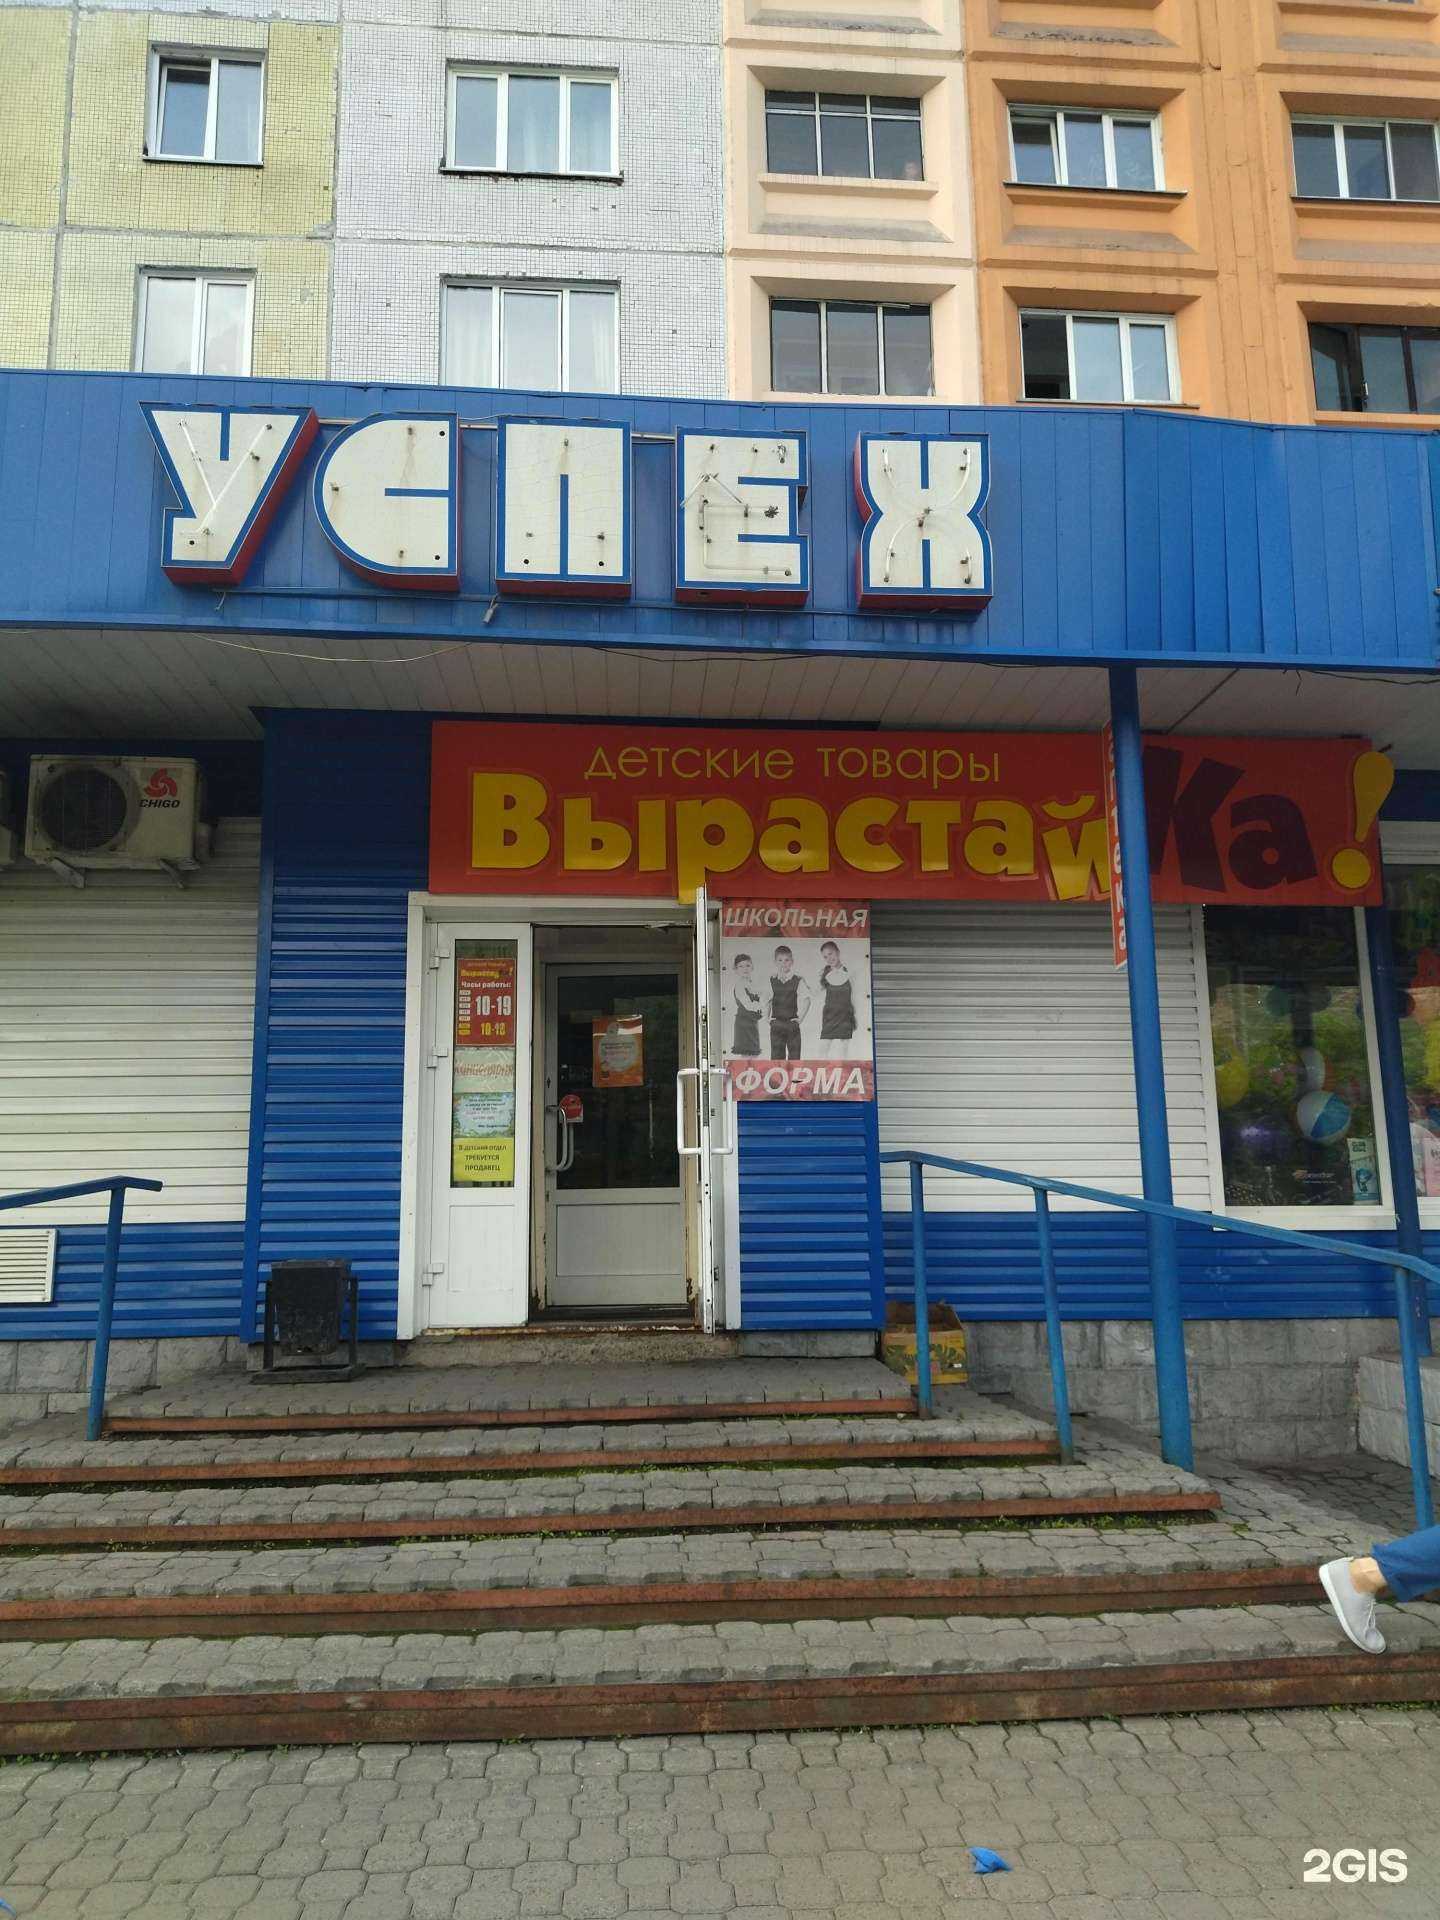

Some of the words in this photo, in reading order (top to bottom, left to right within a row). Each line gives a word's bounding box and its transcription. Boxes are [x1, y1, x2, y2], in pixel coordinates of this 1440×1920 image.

[139, 401, 993, 602] УСПЕХ
[816, 747, 1000, 790] товары
[139, 799, 181, 808] CHIGO
[724, 907, 869, 928] ШКОЛЬНАЯ
[475, 995, 512, 1016] 10-19
[735, 1067, 866, 1095] ФОРМА
